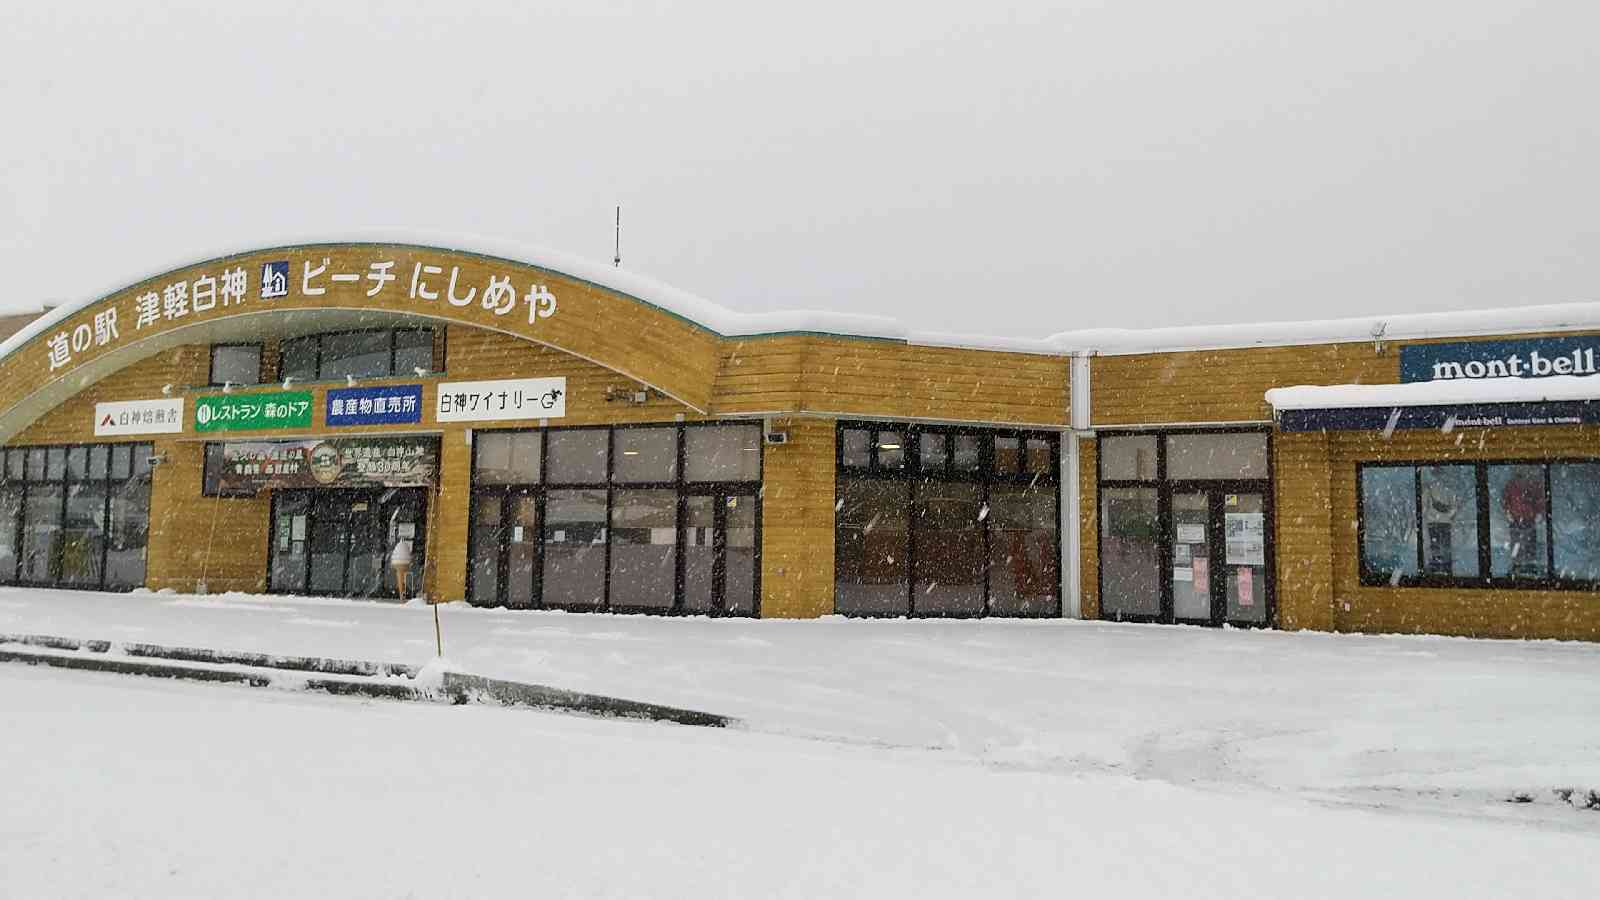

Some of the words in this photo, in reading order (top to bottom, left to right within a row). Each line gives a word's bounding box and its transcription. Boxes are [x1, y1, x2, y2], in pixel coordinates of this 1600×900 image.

[47, 306, 119, 371] 道の駅
[136, 266, 247, 330] 津軽白神
[302, 257, 396, 297] ビーチ
[409, 261, 557, 325] にしめや
[211, 404, 261, 421] レストラン
[264, 401, 309, 418] 森のドア
[331, 395, 417, 416] 農産物直売所
